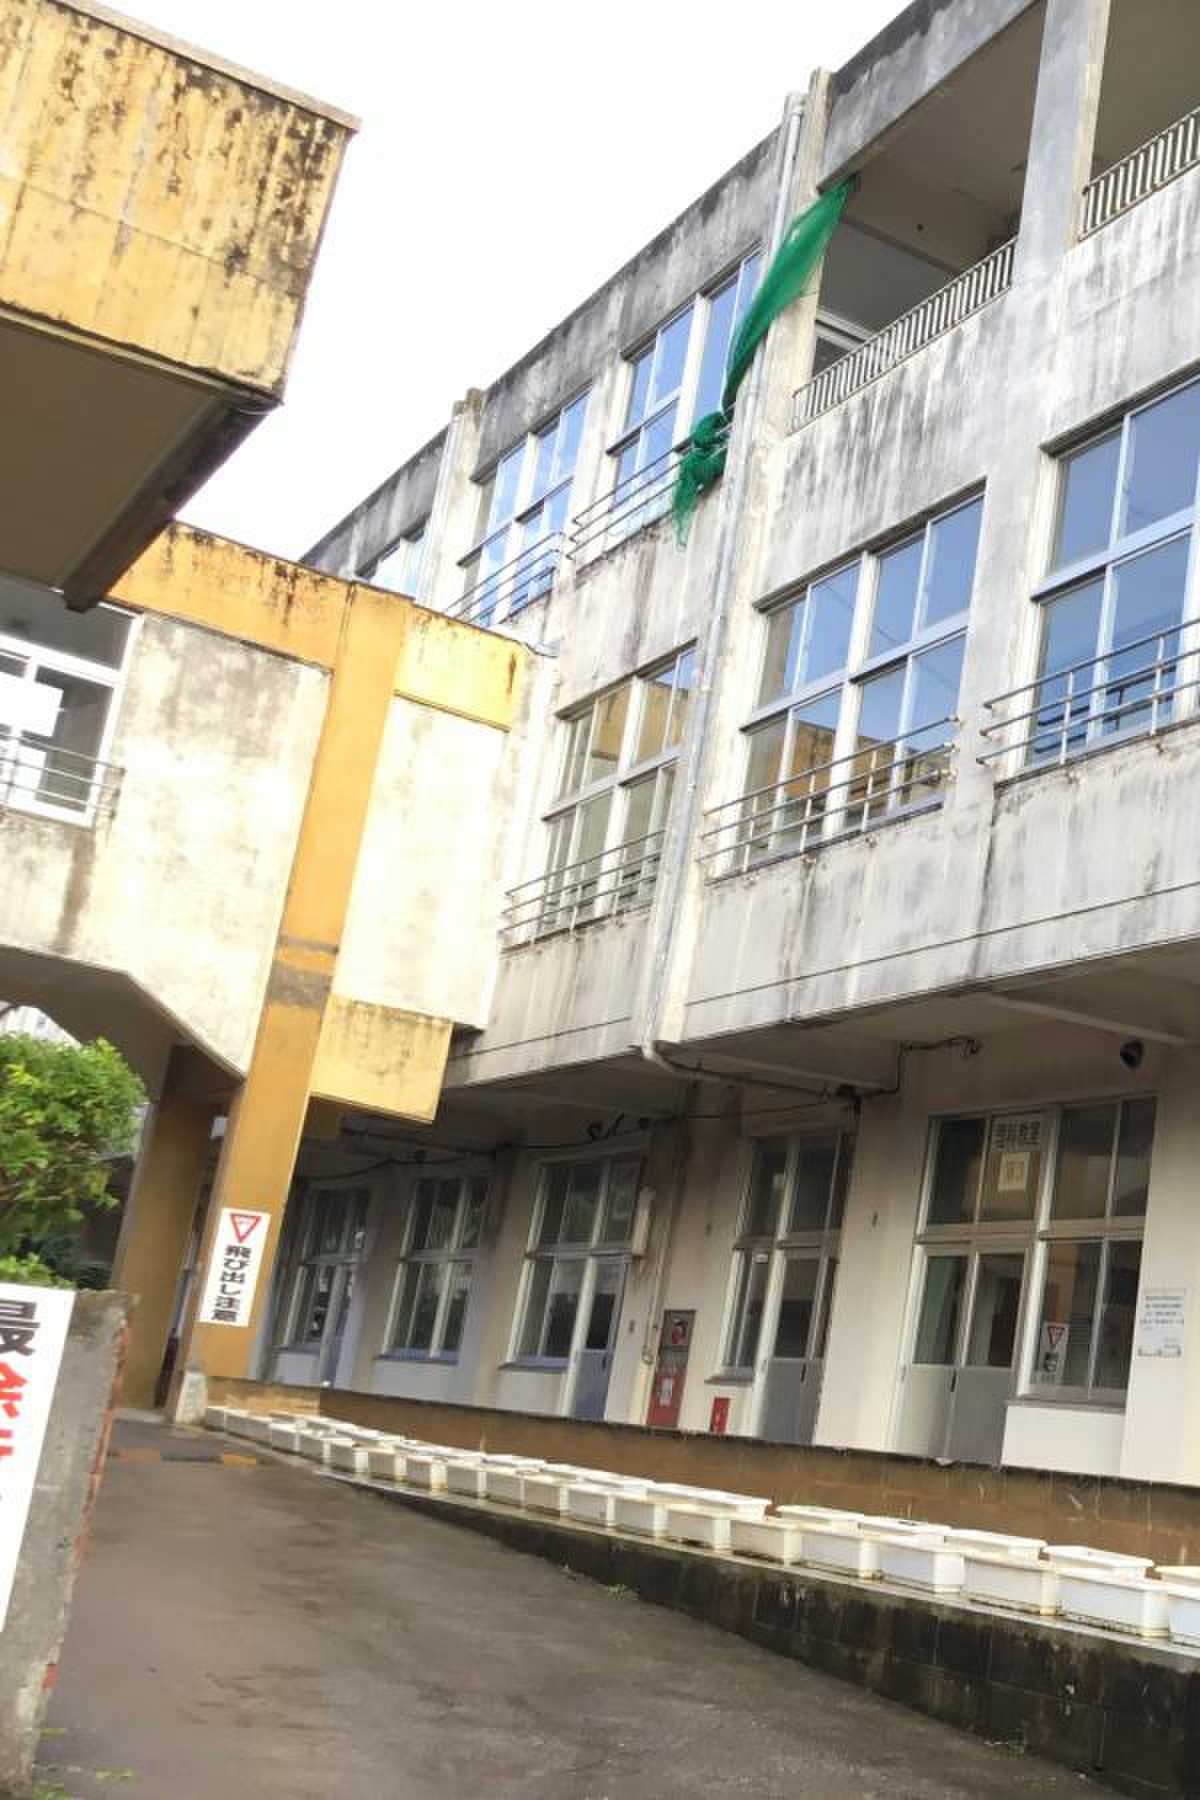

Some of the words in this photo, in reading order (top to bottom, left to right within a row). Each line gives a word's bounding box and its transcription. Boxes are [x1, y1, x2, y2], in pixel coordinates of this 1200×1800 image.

[211, 1245, 252, 1322] 飛び出し注意
